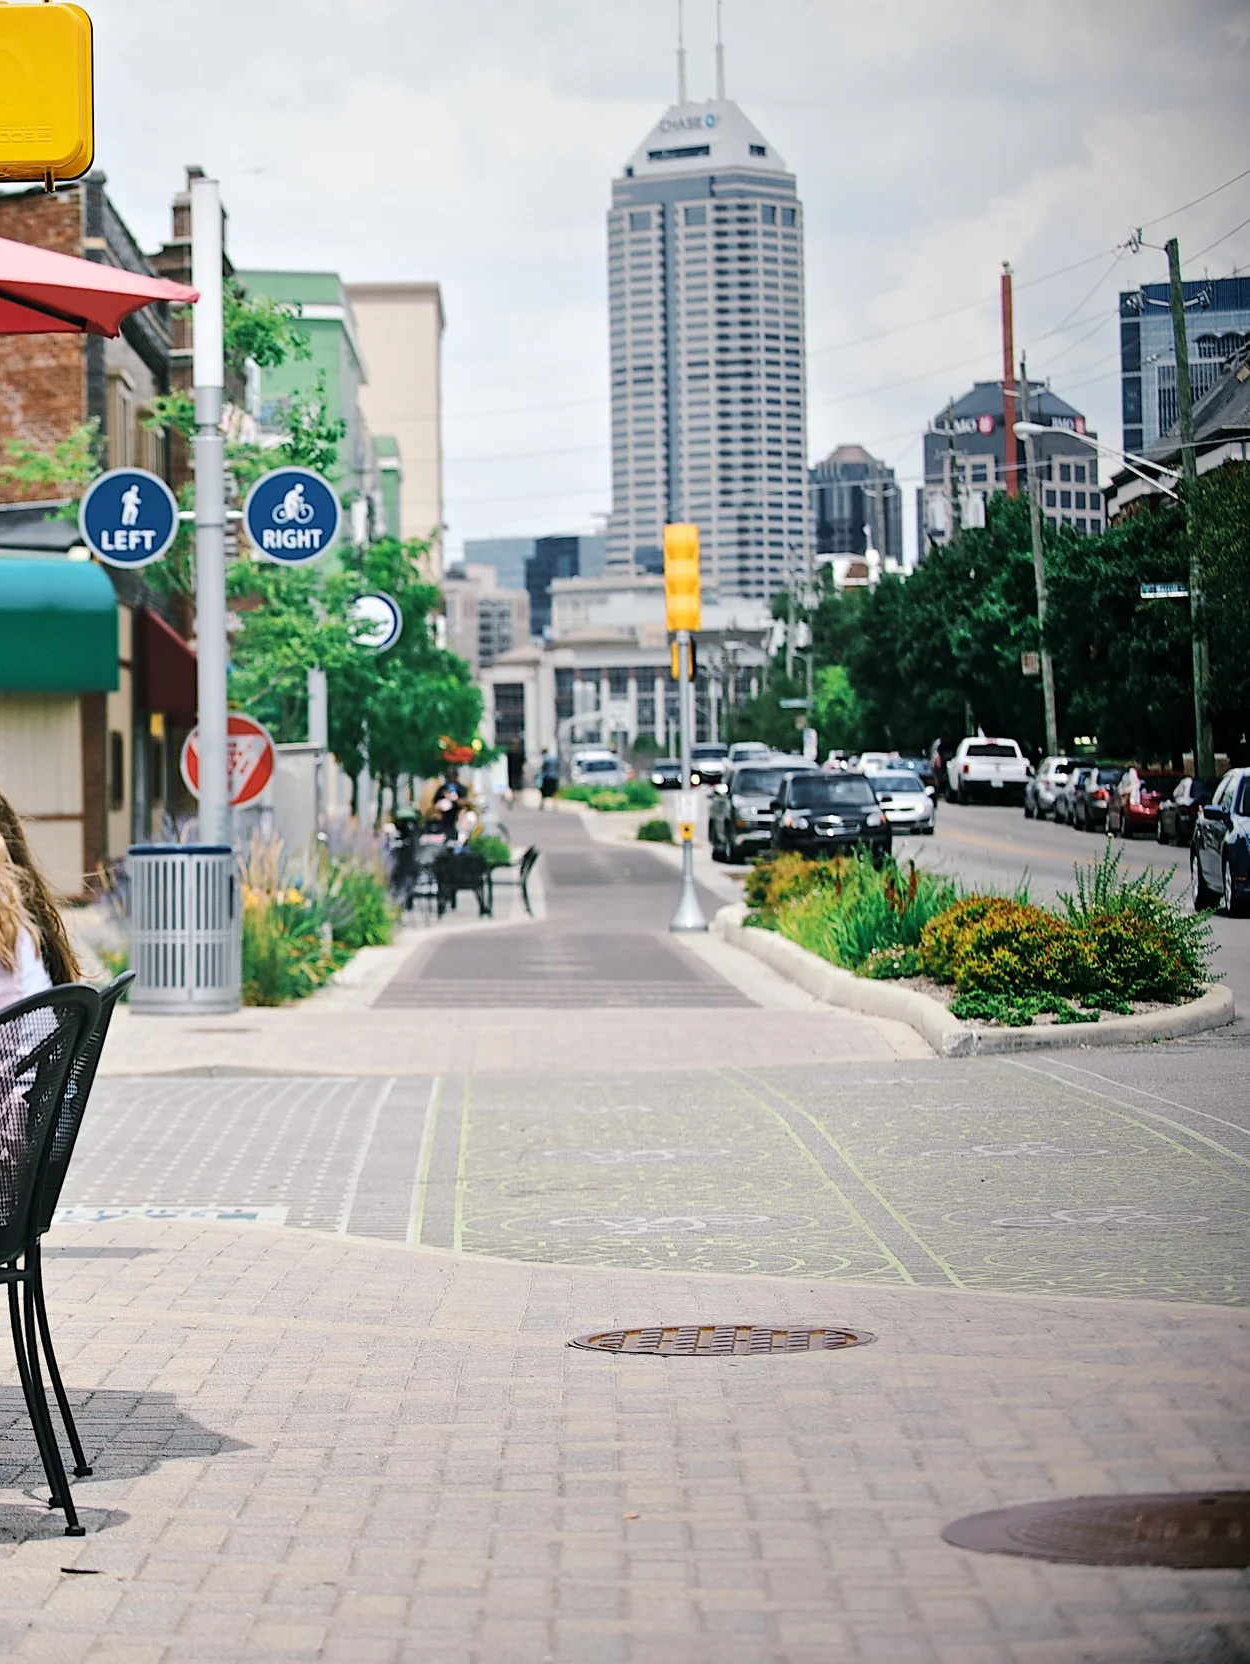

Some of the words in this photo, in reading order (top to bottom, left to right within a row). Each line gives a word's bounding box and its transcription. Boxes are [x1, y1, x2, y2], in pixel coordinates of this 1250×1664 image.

[659, 115, 702, 133] CHASE
[101, 529, 157, 551] LEFT
[262, 528, 323, 549] RIGHT
